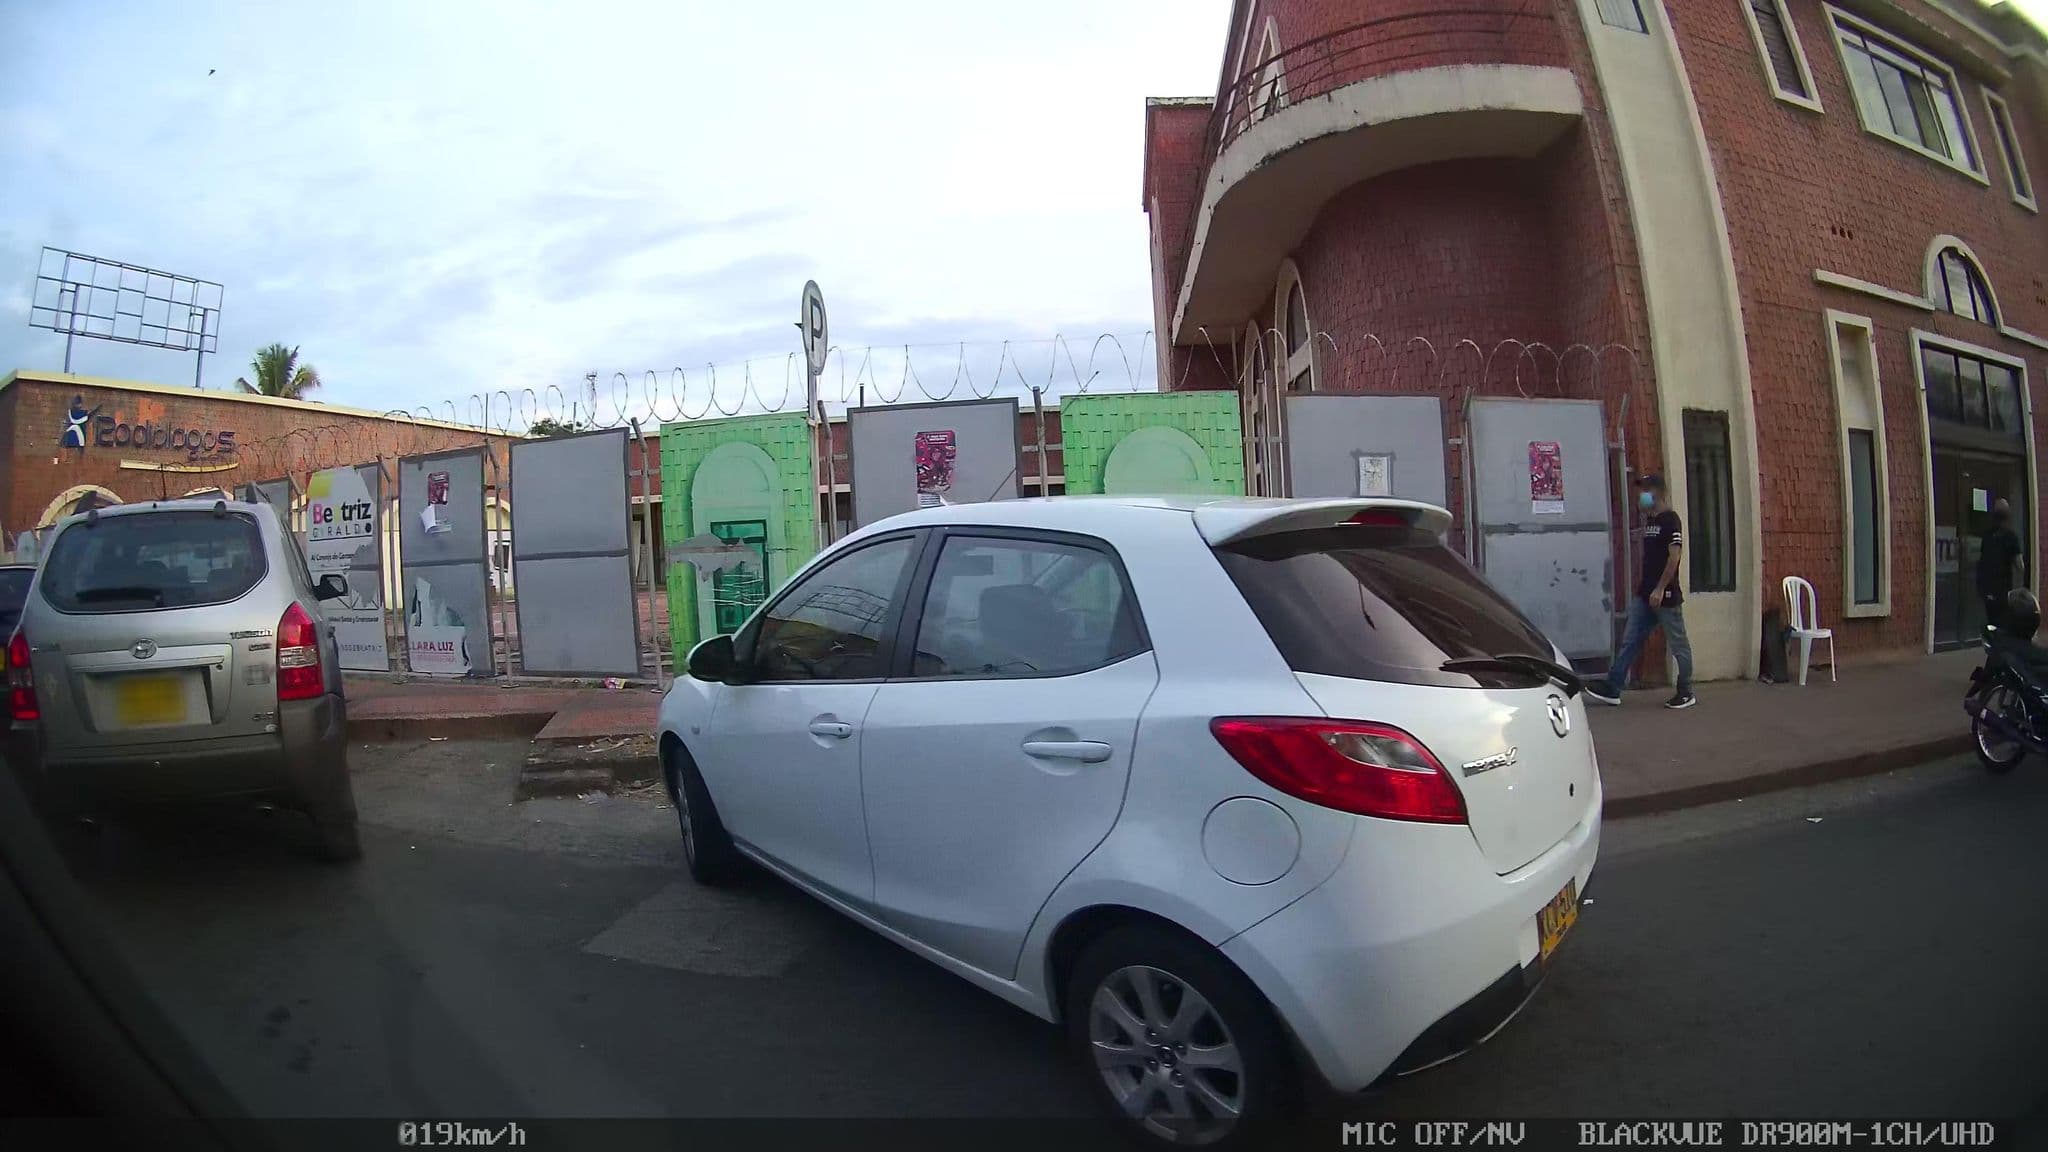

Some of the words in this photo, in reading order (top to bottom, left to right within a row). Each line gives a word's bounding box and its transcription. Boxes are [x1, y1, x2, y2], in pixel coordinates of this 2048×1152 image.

[810, 295, 824, 352] P
[408, 641, 436, 651] LARA
[437, 641, 454, 652] LUZ
